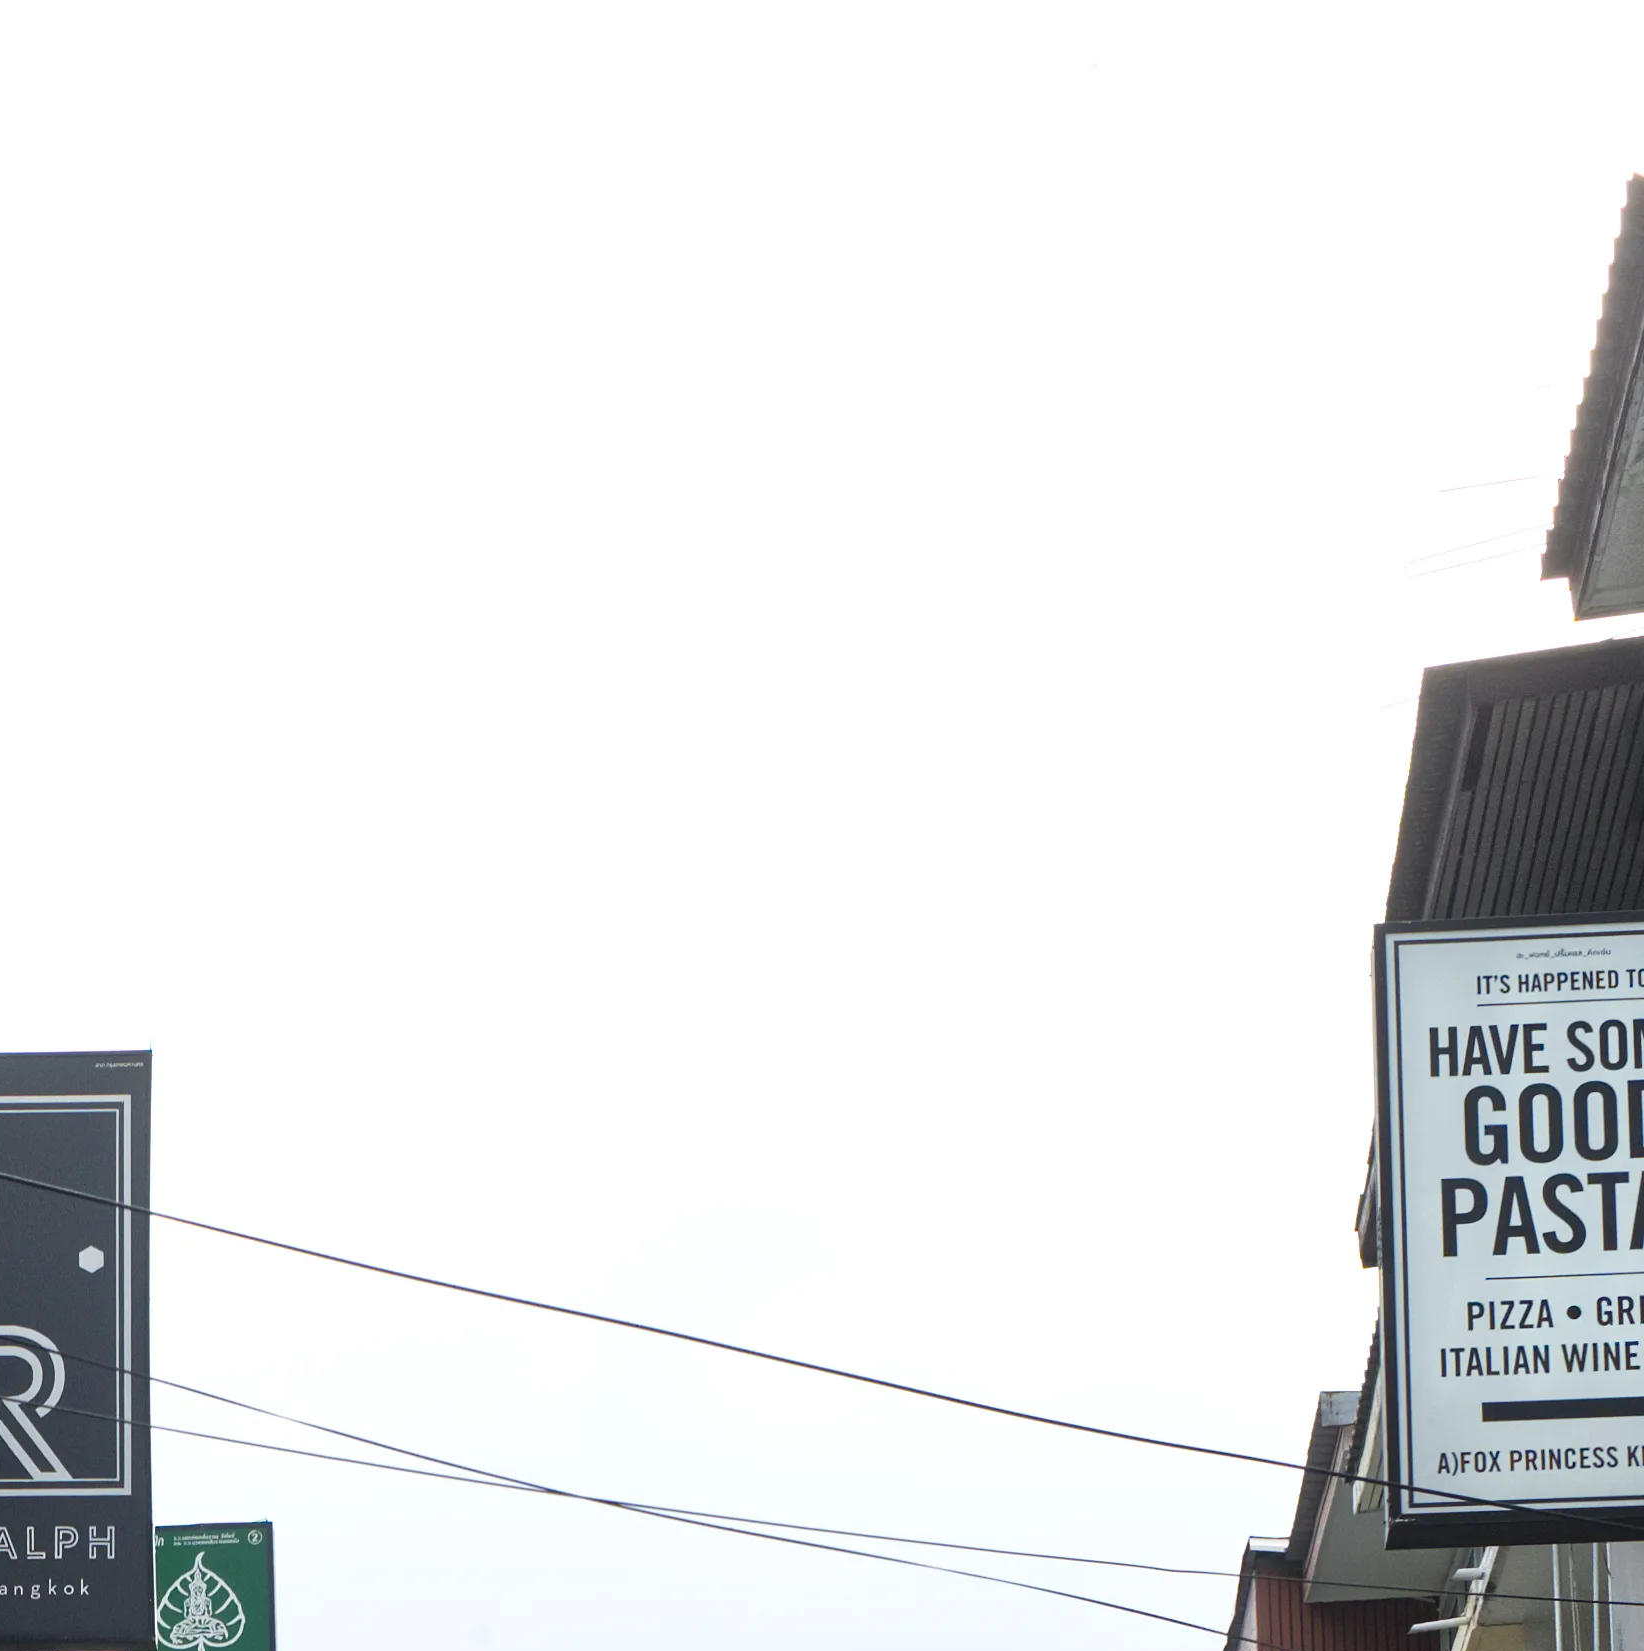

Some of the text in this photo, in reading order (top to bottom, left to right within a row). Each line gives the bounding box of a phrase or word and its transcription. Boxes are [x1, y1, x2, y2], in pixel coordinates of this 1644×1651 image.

[1476, 974, 1511, 995] IT'S
[1518, 969, 1619, 993] HAPPENED
[1429, 1023, 1550, 1077] HAVE
[1467, 1299, 1554, 1331] PIZZA
[1440, 1340, 1641, 1377] ITALIAN WINE
[1437, 1450, 1501, 1476] A)FOX
[1509, 1446, 1619, 1471] PRINCESS
